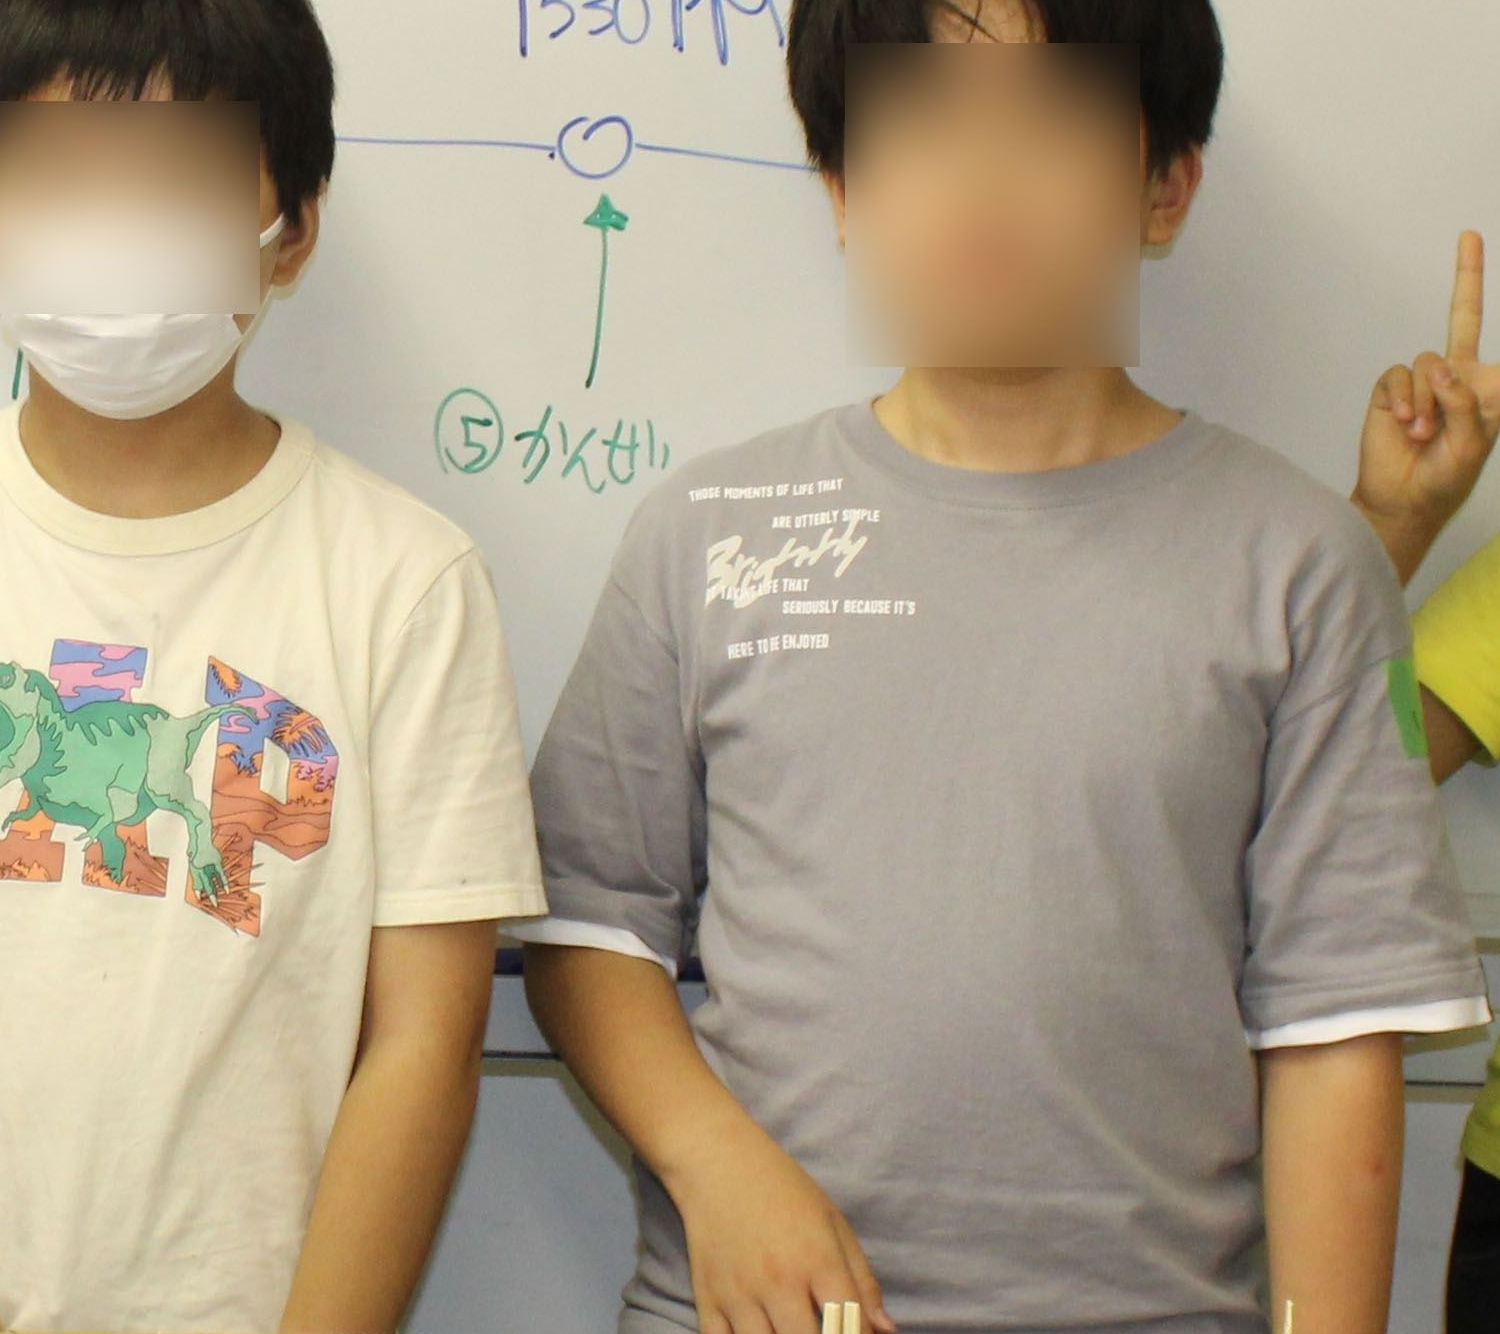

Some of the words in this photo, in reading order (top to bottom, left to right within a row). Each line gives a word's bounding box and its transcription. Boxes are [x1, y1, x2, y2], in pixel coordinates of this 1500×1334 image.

[688, 486, 721, 503] THOSE
[724, 485, 773, 500] MOMENTS
[776, 483, 789, 497] OF
[793, 482, 814, 496] LIFE
[818, 478, 844, 493] THAT
[772, 516, 792, 529] ARE
[794, 510, 839, 528] UTTERLY
[782, 578, 810, 592] THAT
[782, 599, 838, 615] SERIOUSLY
[843, 600, 892, 615] BECAUSE
[894, 599, 917, 615] IT'S
[727, 640, 754, 660] HERE
[756, 637, 769, 654] TO
[769, 635, 780, 652] BE
[782, 633, 829, 650] ENJOYED
